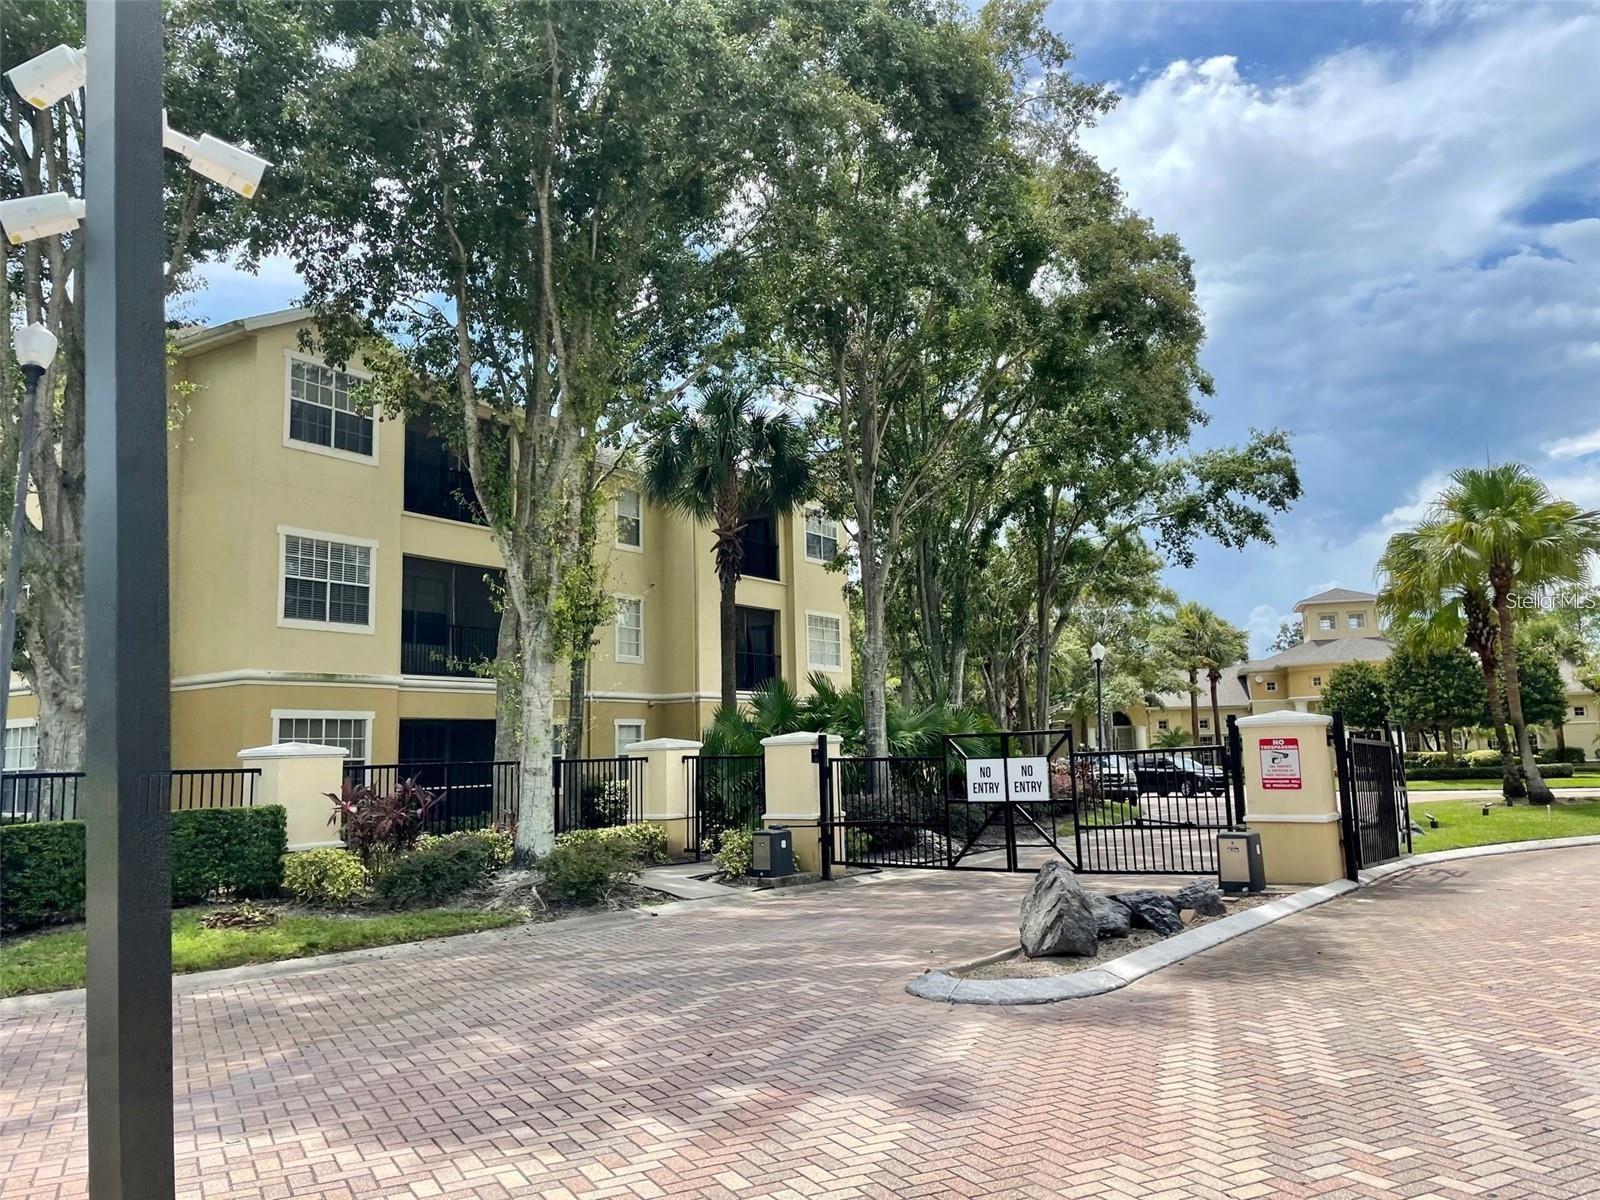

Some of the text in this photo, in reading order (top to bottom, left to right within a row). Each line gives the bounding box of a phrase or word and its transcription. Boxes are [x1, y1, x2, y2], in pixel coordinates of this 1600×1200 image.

[979, 766, 991, 778] NO
[1021, 765, 1033, 777] NO
[973, 782, 1000, 794] ENTRY
[1014, 781, 1042, 793] ENTRY
